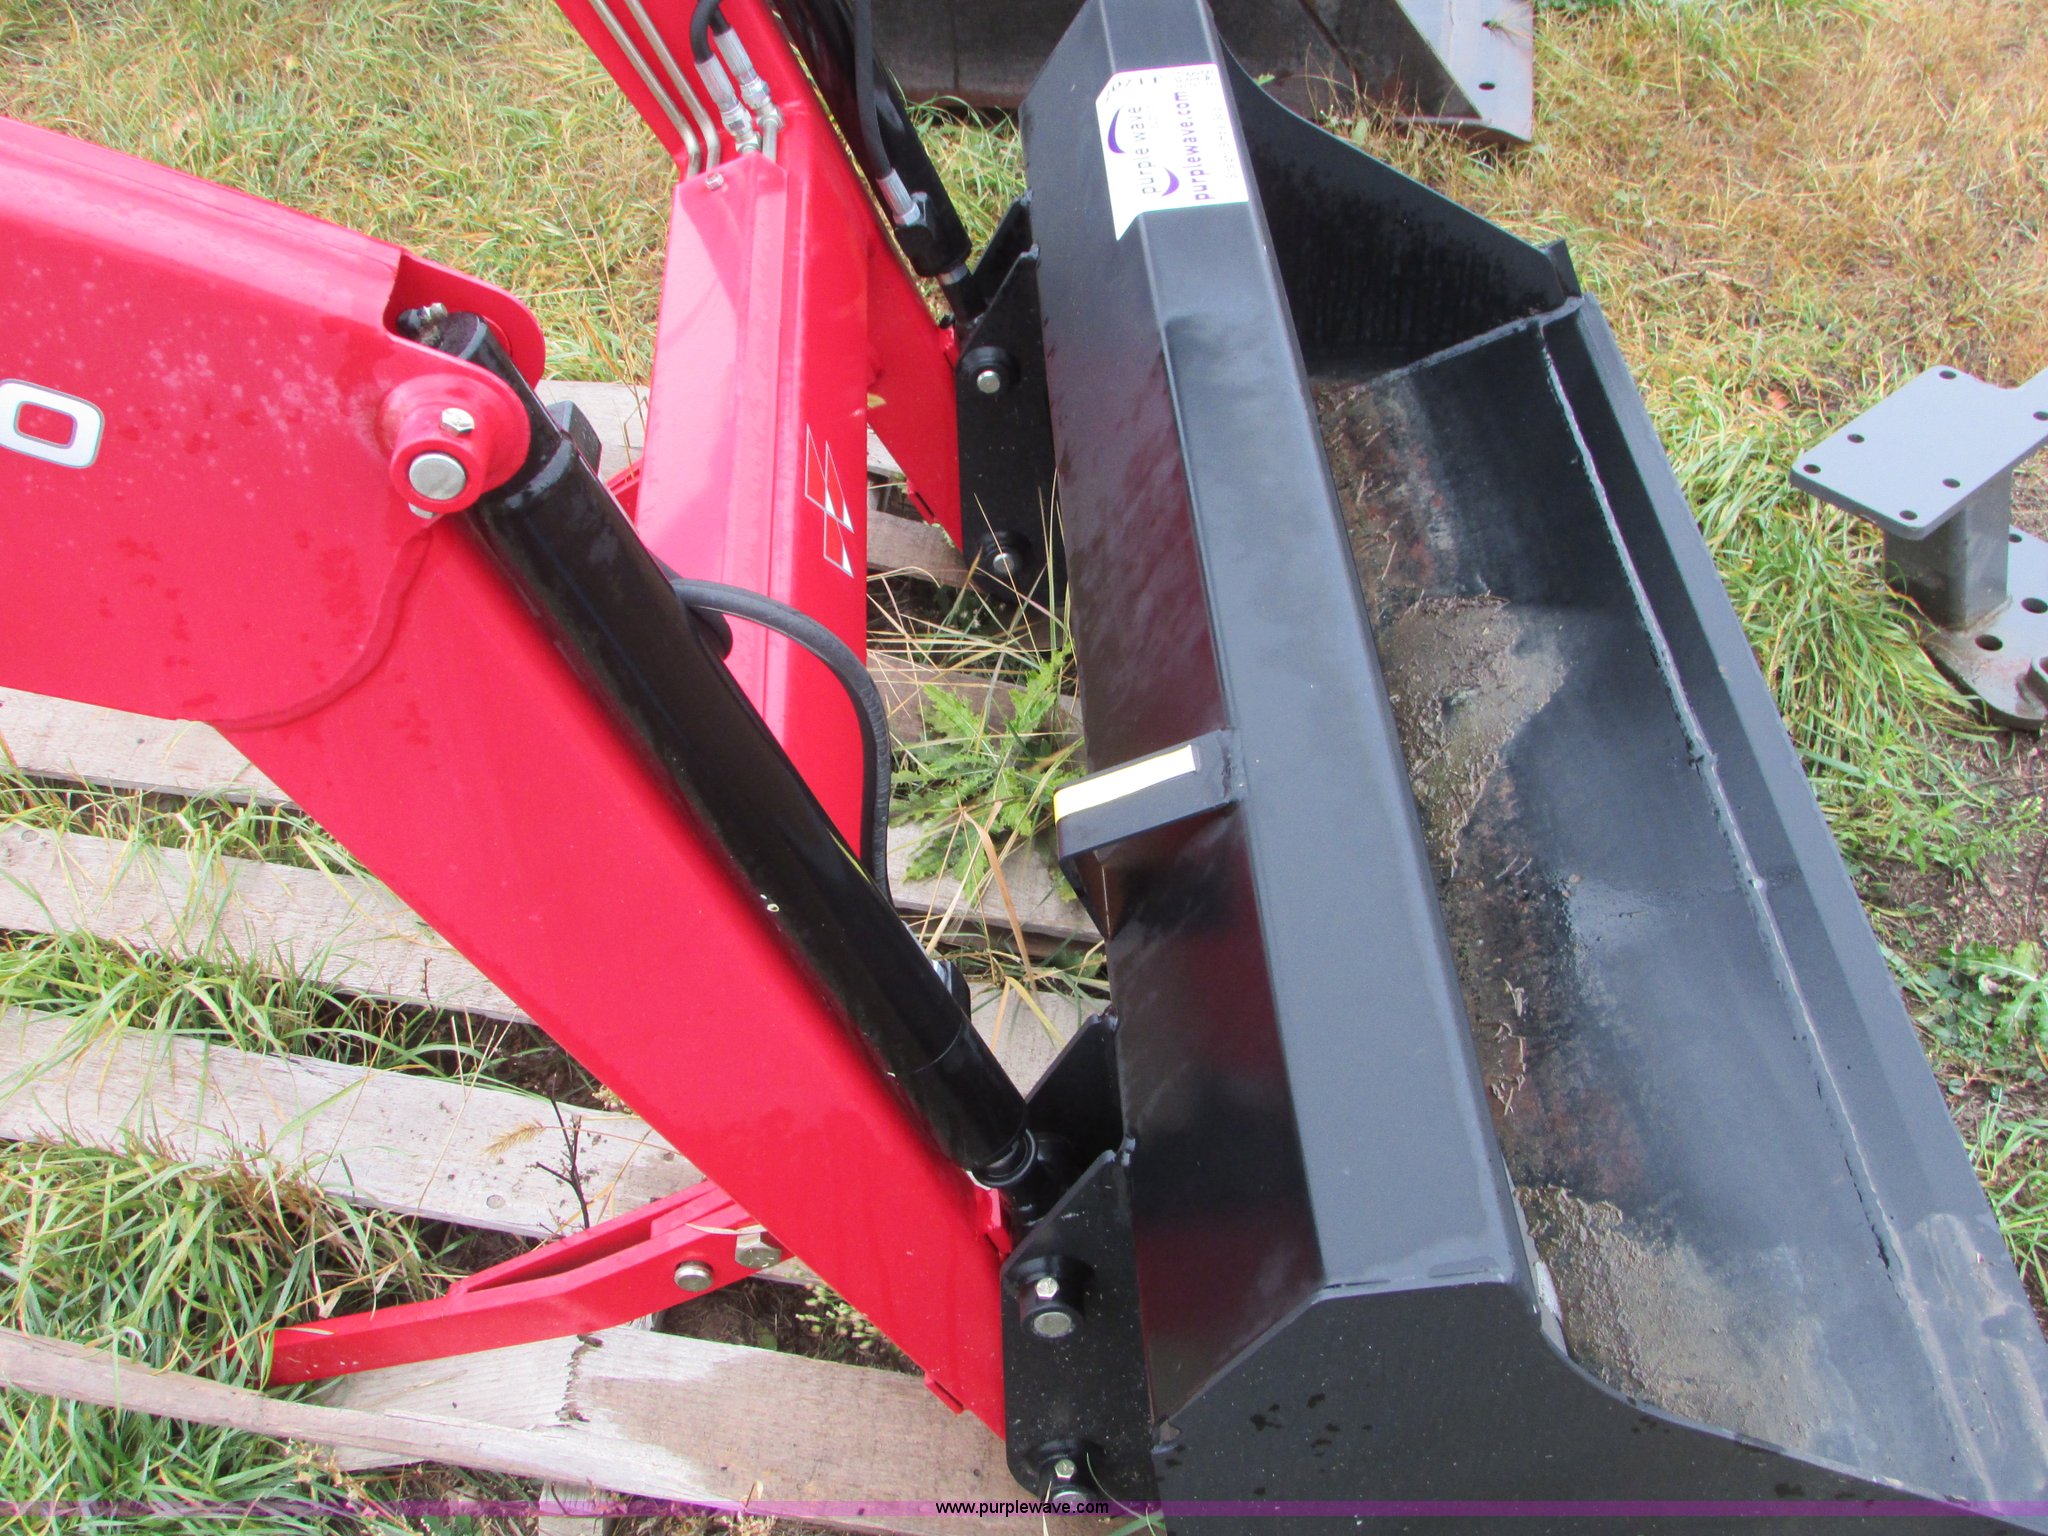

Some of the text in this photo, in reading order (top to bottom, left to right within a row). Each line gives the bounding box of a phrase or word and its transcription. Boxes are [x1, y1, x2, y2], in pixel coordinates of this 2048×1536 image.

[1127, 106, 1147, 142] wave
[1173, 91, 1216, 201] purplewave.com
[1132, 147, 1162, 195] purple
